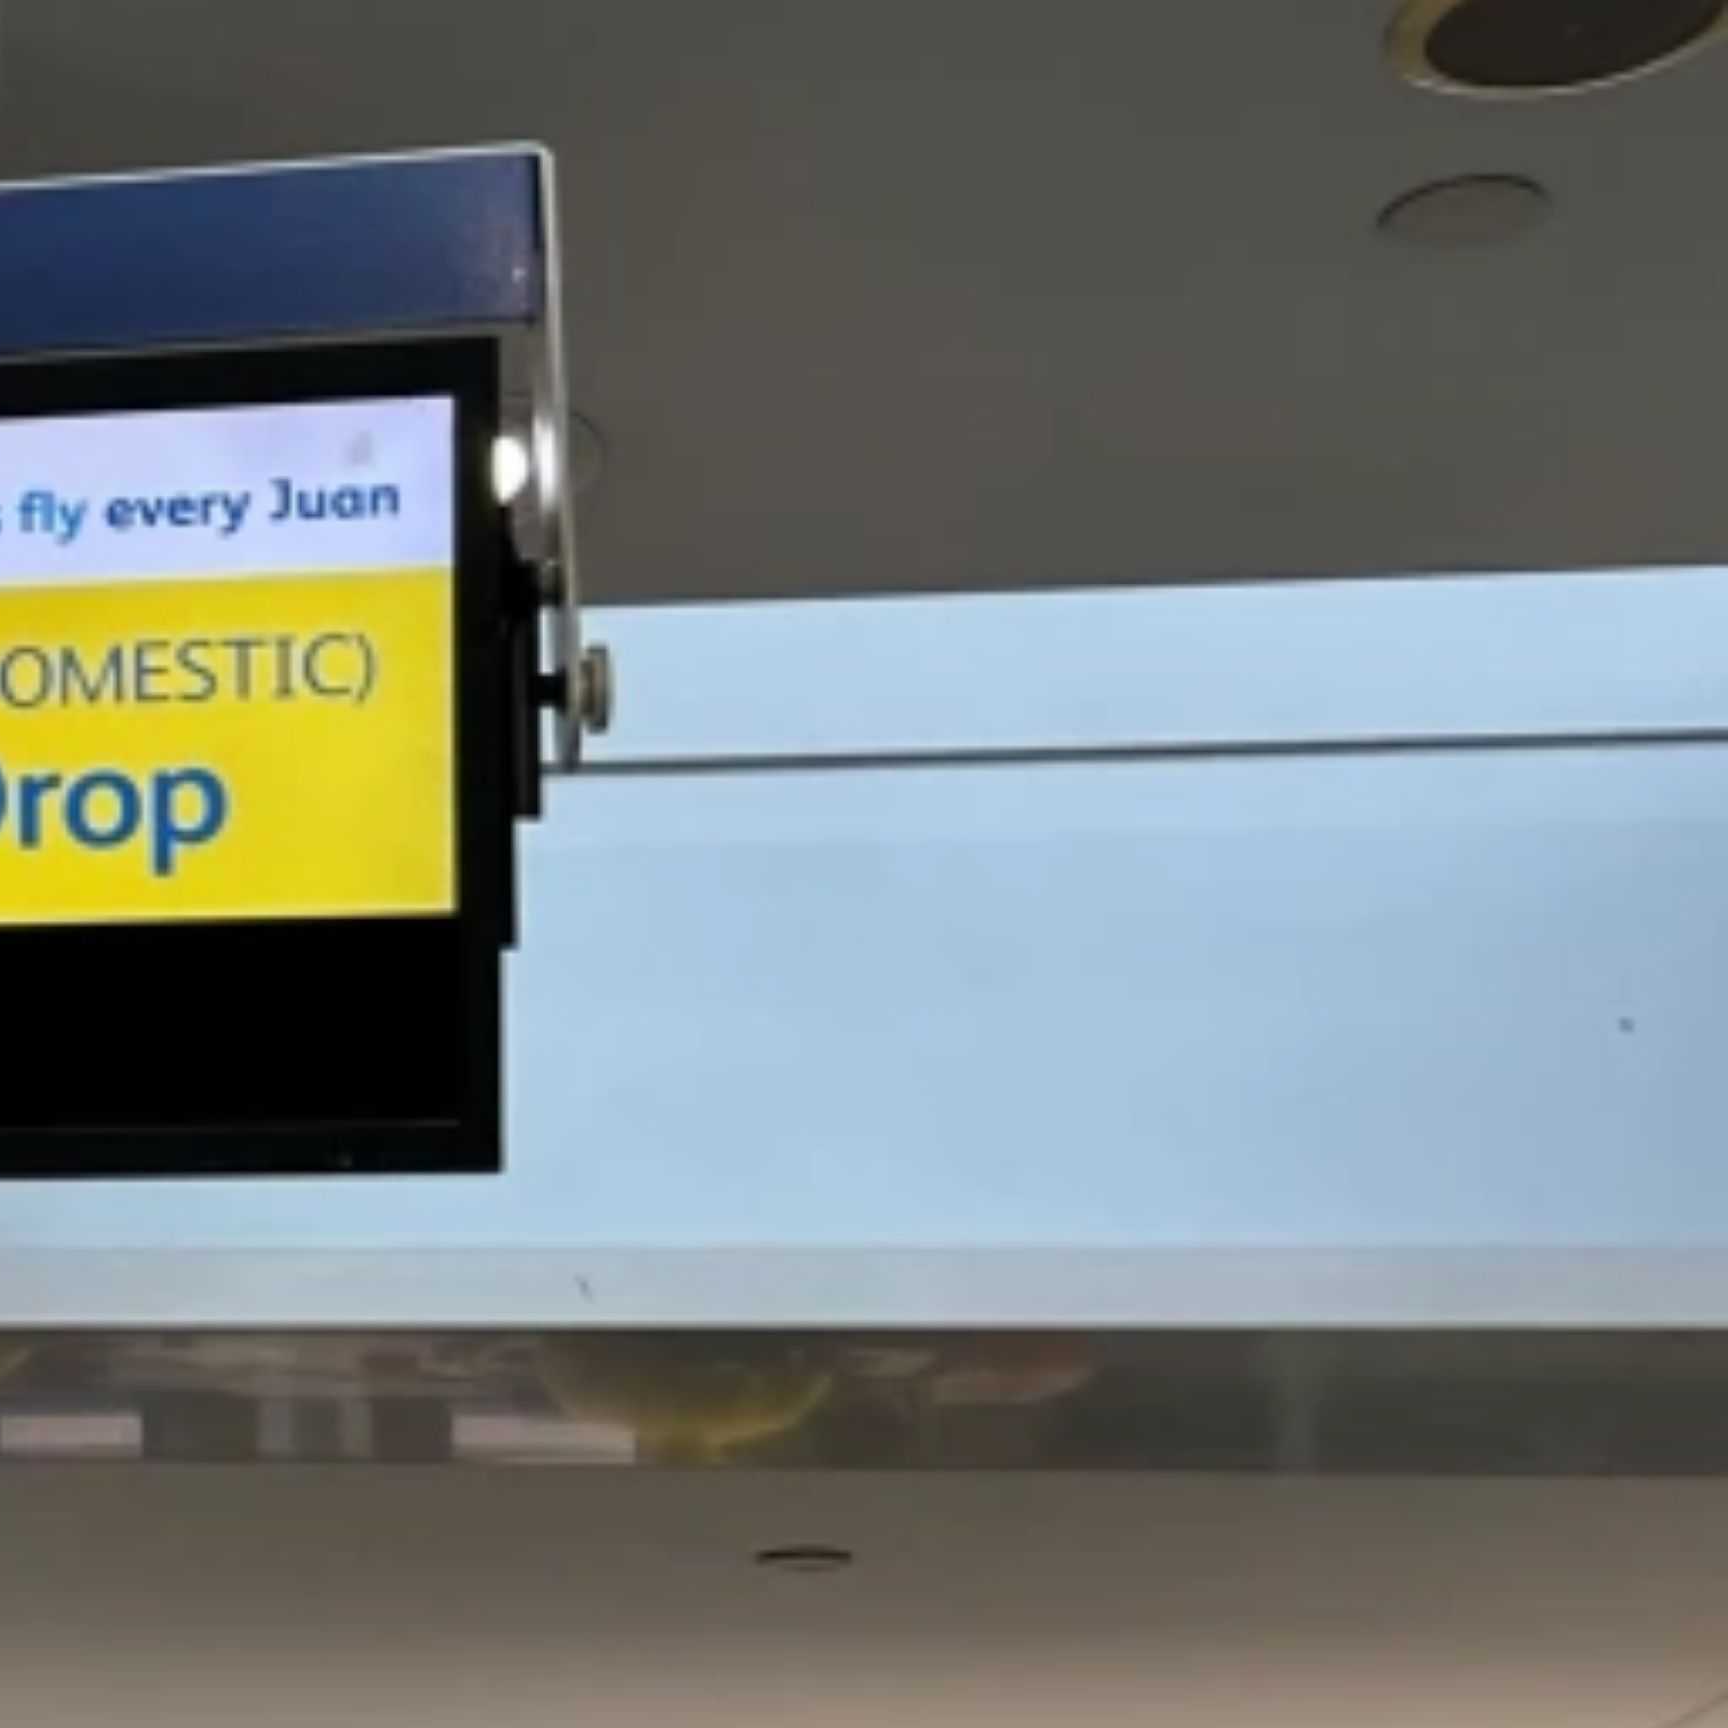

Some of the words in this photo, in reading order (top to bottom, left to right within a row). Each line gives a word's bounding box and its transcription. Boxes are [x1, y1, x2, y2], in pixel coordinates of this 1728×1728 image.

[18, 486, 88, 543] fly
[103, 488, 252, 535] every
[268, 475, 402, 523] Juan
